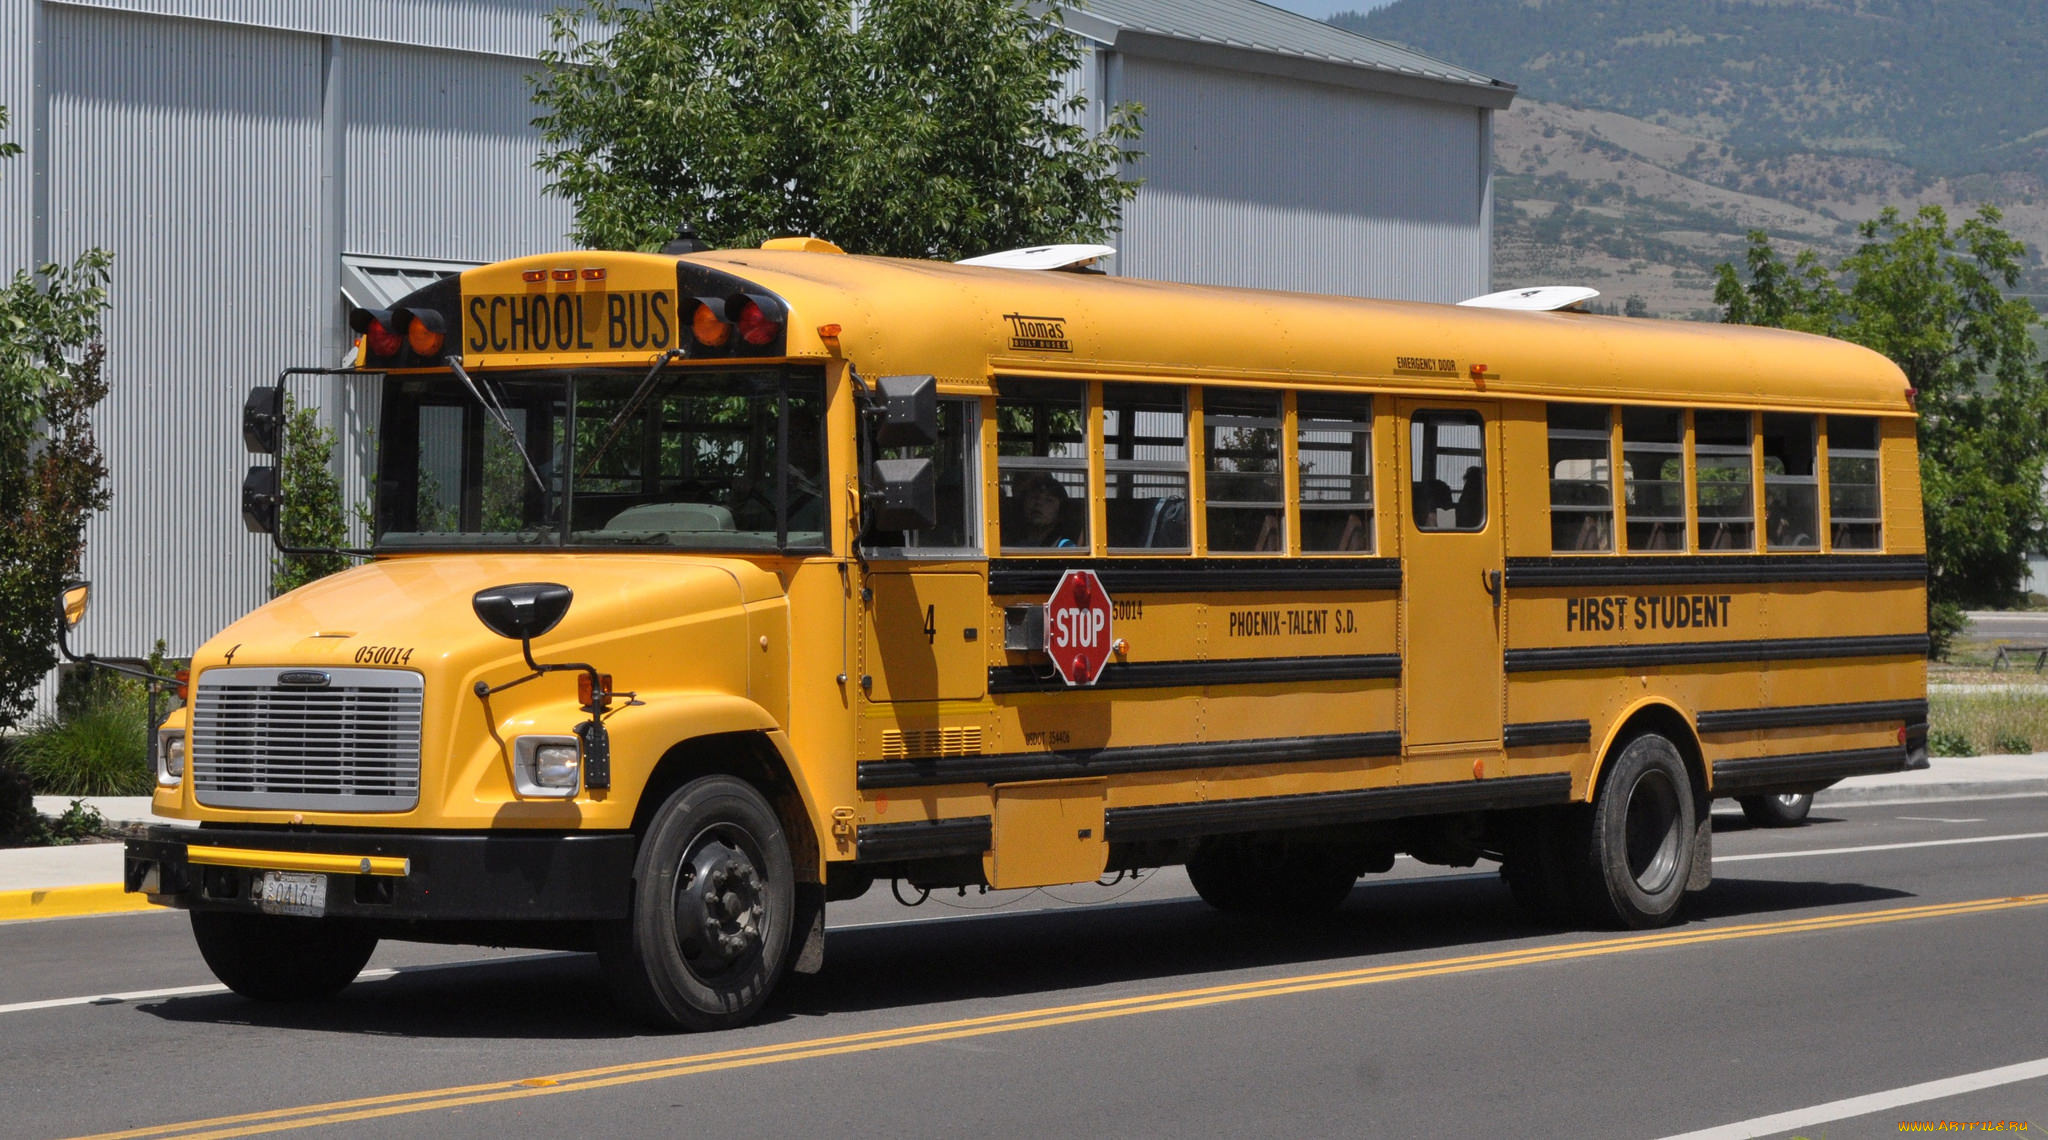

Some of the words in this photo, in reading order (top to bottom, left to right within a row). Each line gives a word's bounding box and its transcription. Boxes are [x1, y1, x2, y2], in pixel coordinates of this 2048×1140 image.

[469, 293, 593, 352] SCHOOL
[608, 291, 670, 349] BUS
[1003, 312, 1066, 339] Thomas
[1396, 357, 1436, 371] EMERGENCY
[1438, 359, 1456, 371] DOOR
[923, 604, 936, 645] 4
[1056, 607, 1105, 648] STOP
[1229, 610, 1328, 637] PHOENIX-TALENT
[1335, 609, 1358, 634] S.D.
[1567, 597, 1627, 632] FIRST
[1634, 595, 1731, 630] STUDENT
[224, 643, 242, 665] 4
[354, 646, 414, 665] 050014
